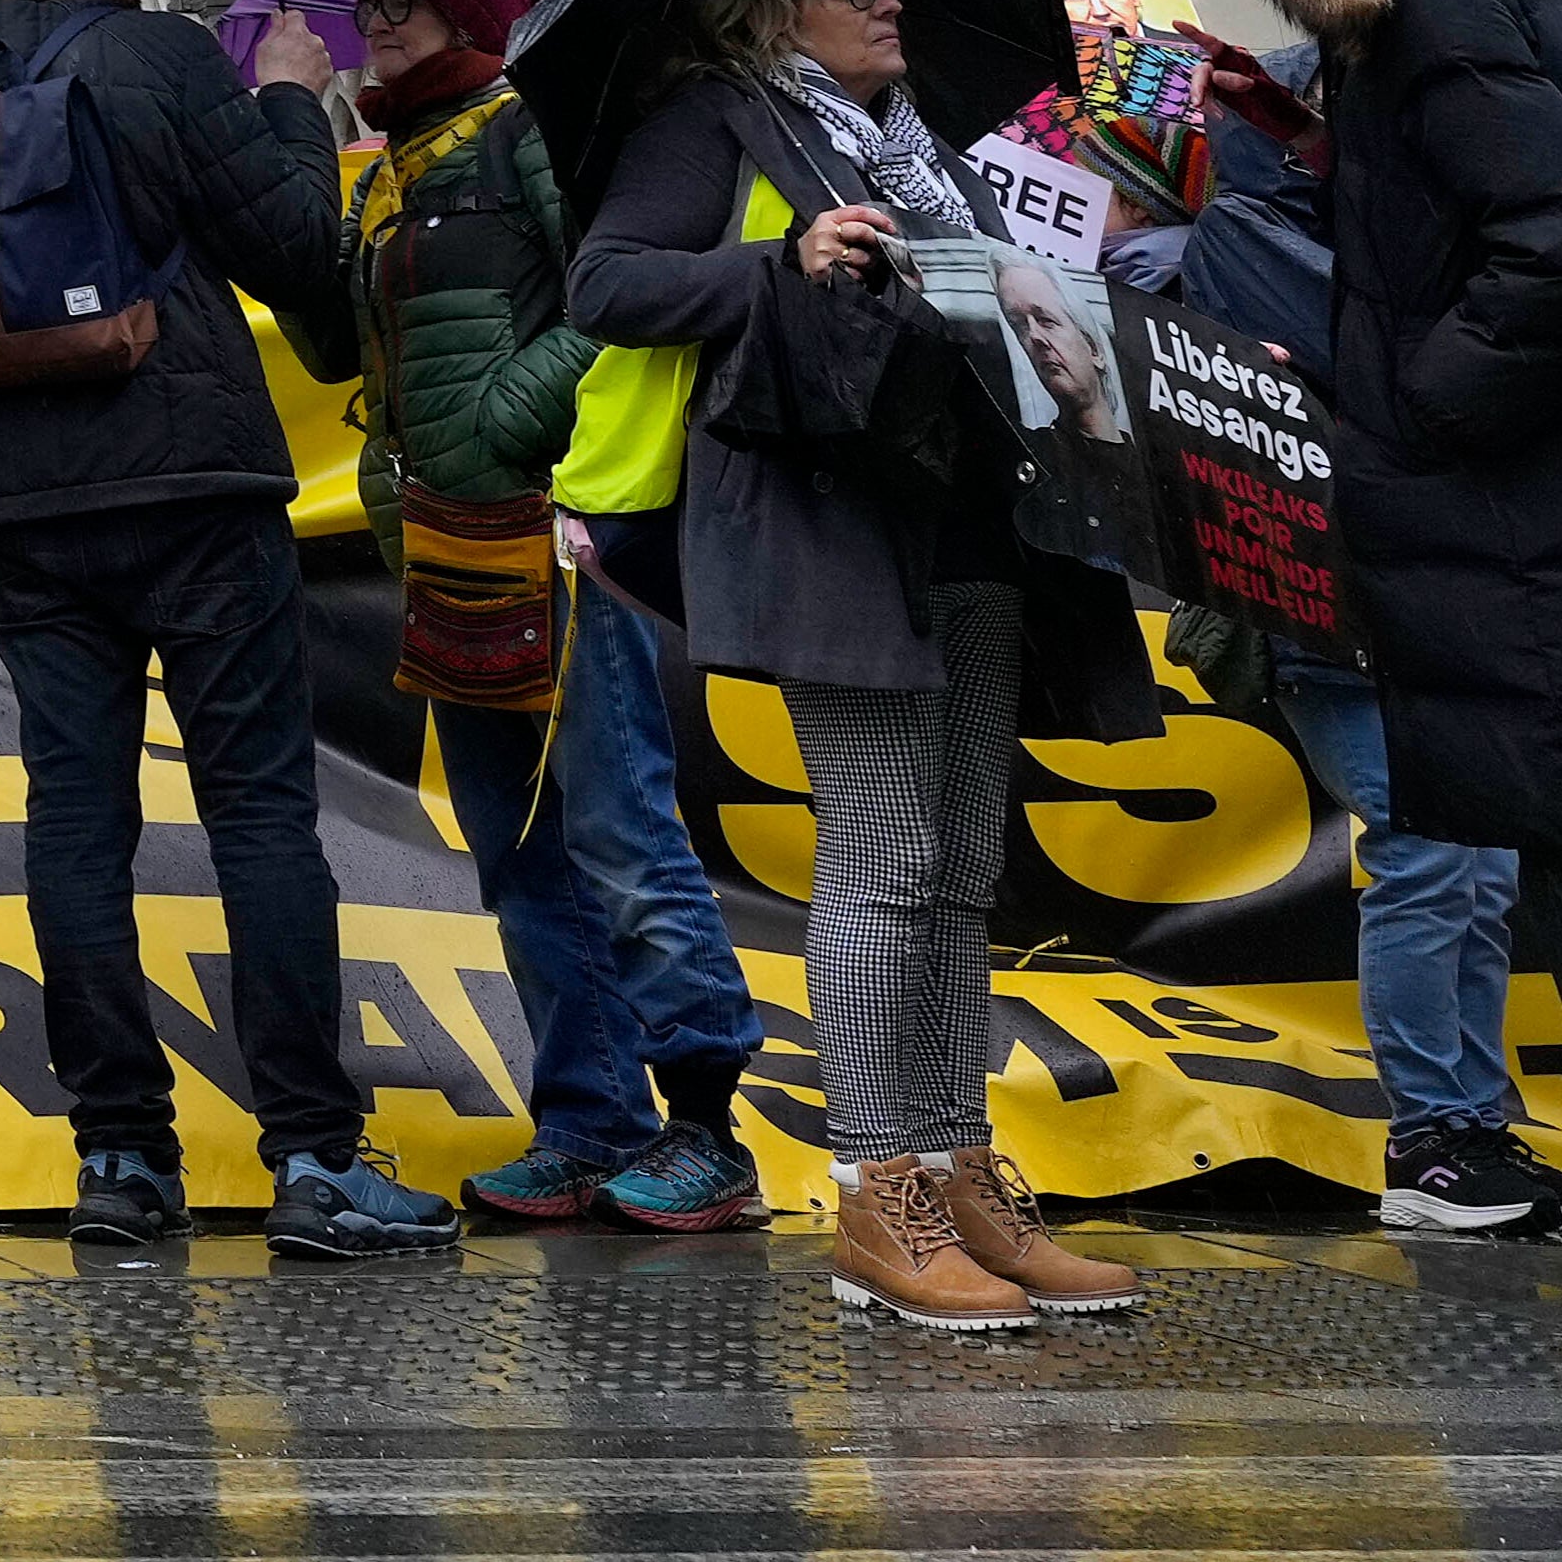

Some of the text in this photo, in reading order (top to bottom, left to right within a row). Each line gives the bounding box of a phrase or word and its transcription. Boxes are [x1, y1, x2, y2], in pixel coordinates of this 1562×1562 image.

[959, 153, 1088, 239] REE
[1145, 316, 1308, 422] Libérez
[1149, 368, 1332, 482] Assange
[1181, 448, 1328, 532] WIKILEAKS
[1194, 517, 1235, 560] UN
[1211, 557, 1337, 633] MEILEUR
[1094, 997, 1280, 1044] IS
